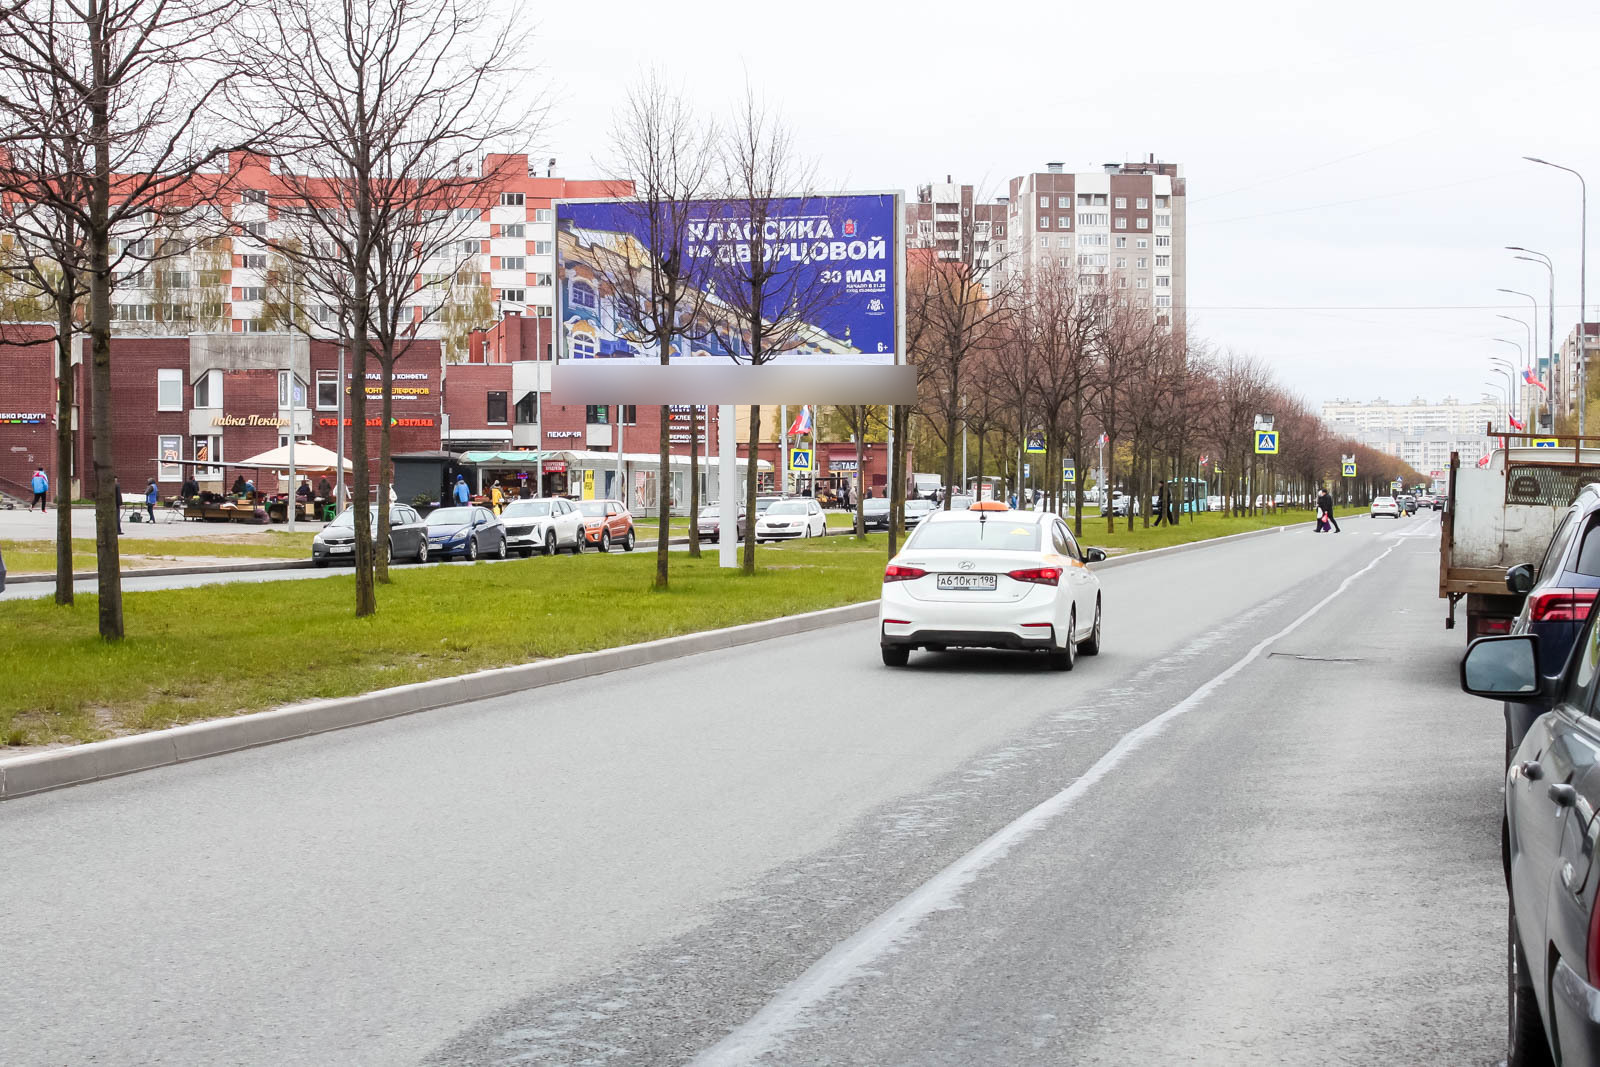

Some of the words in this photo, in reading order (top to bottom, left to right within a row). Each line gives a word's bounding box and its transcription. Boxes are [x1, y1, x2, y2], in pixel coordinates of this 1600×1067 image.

[688, 219, 835, 242] КЛАССИКА
[688, 244, 713, 259] НА
[714, 235, 886, 267] ДВОРЦОВОЙ
[820, 270, 842, 284] 30
[846, 269, 886, 283] МАЯ
[877, 342, 888, 352] 6+
[391, 387, 429, 395] ЕЛЕФОНОВ
[841, 462, 858, 470] ТАБА
